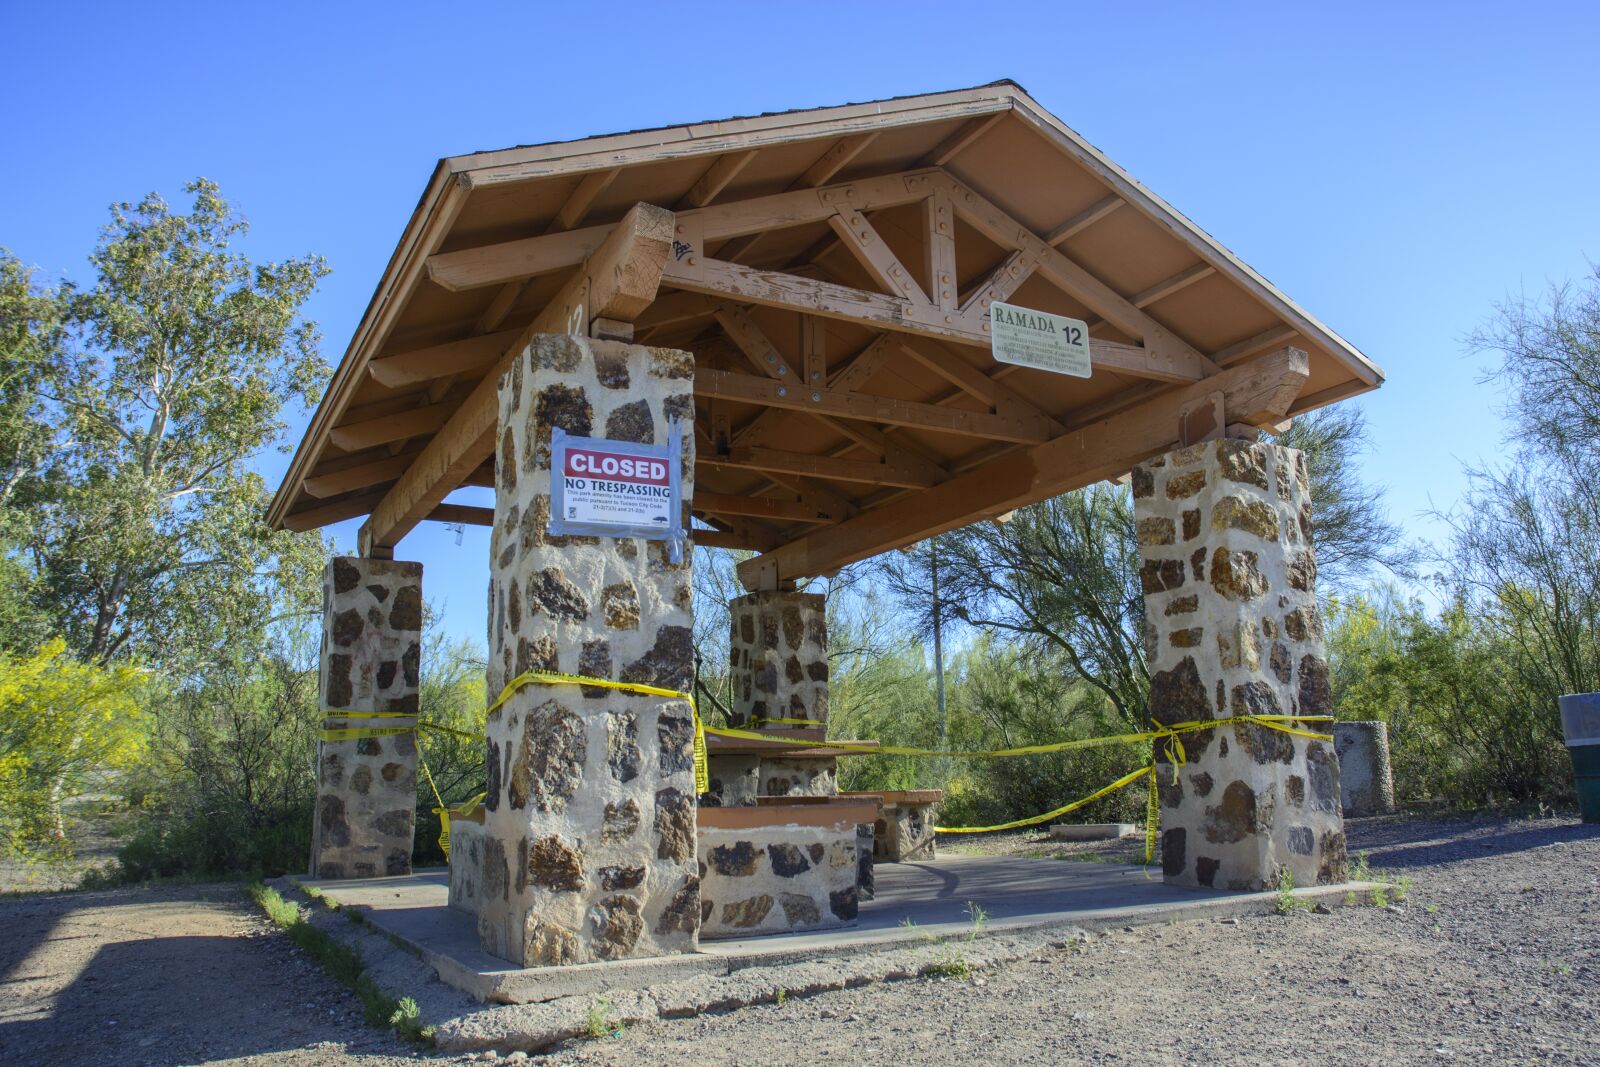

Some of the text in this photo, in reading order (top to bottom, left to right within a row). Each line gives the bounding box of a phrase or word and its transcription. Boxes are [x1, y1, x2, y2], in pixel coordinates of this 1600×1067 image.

[995, 307, 1083, 346] RAMADA 12
[570, 454, 666, 480] CLOSED
[565, 478, 670, 498] NO TRESPASSING
